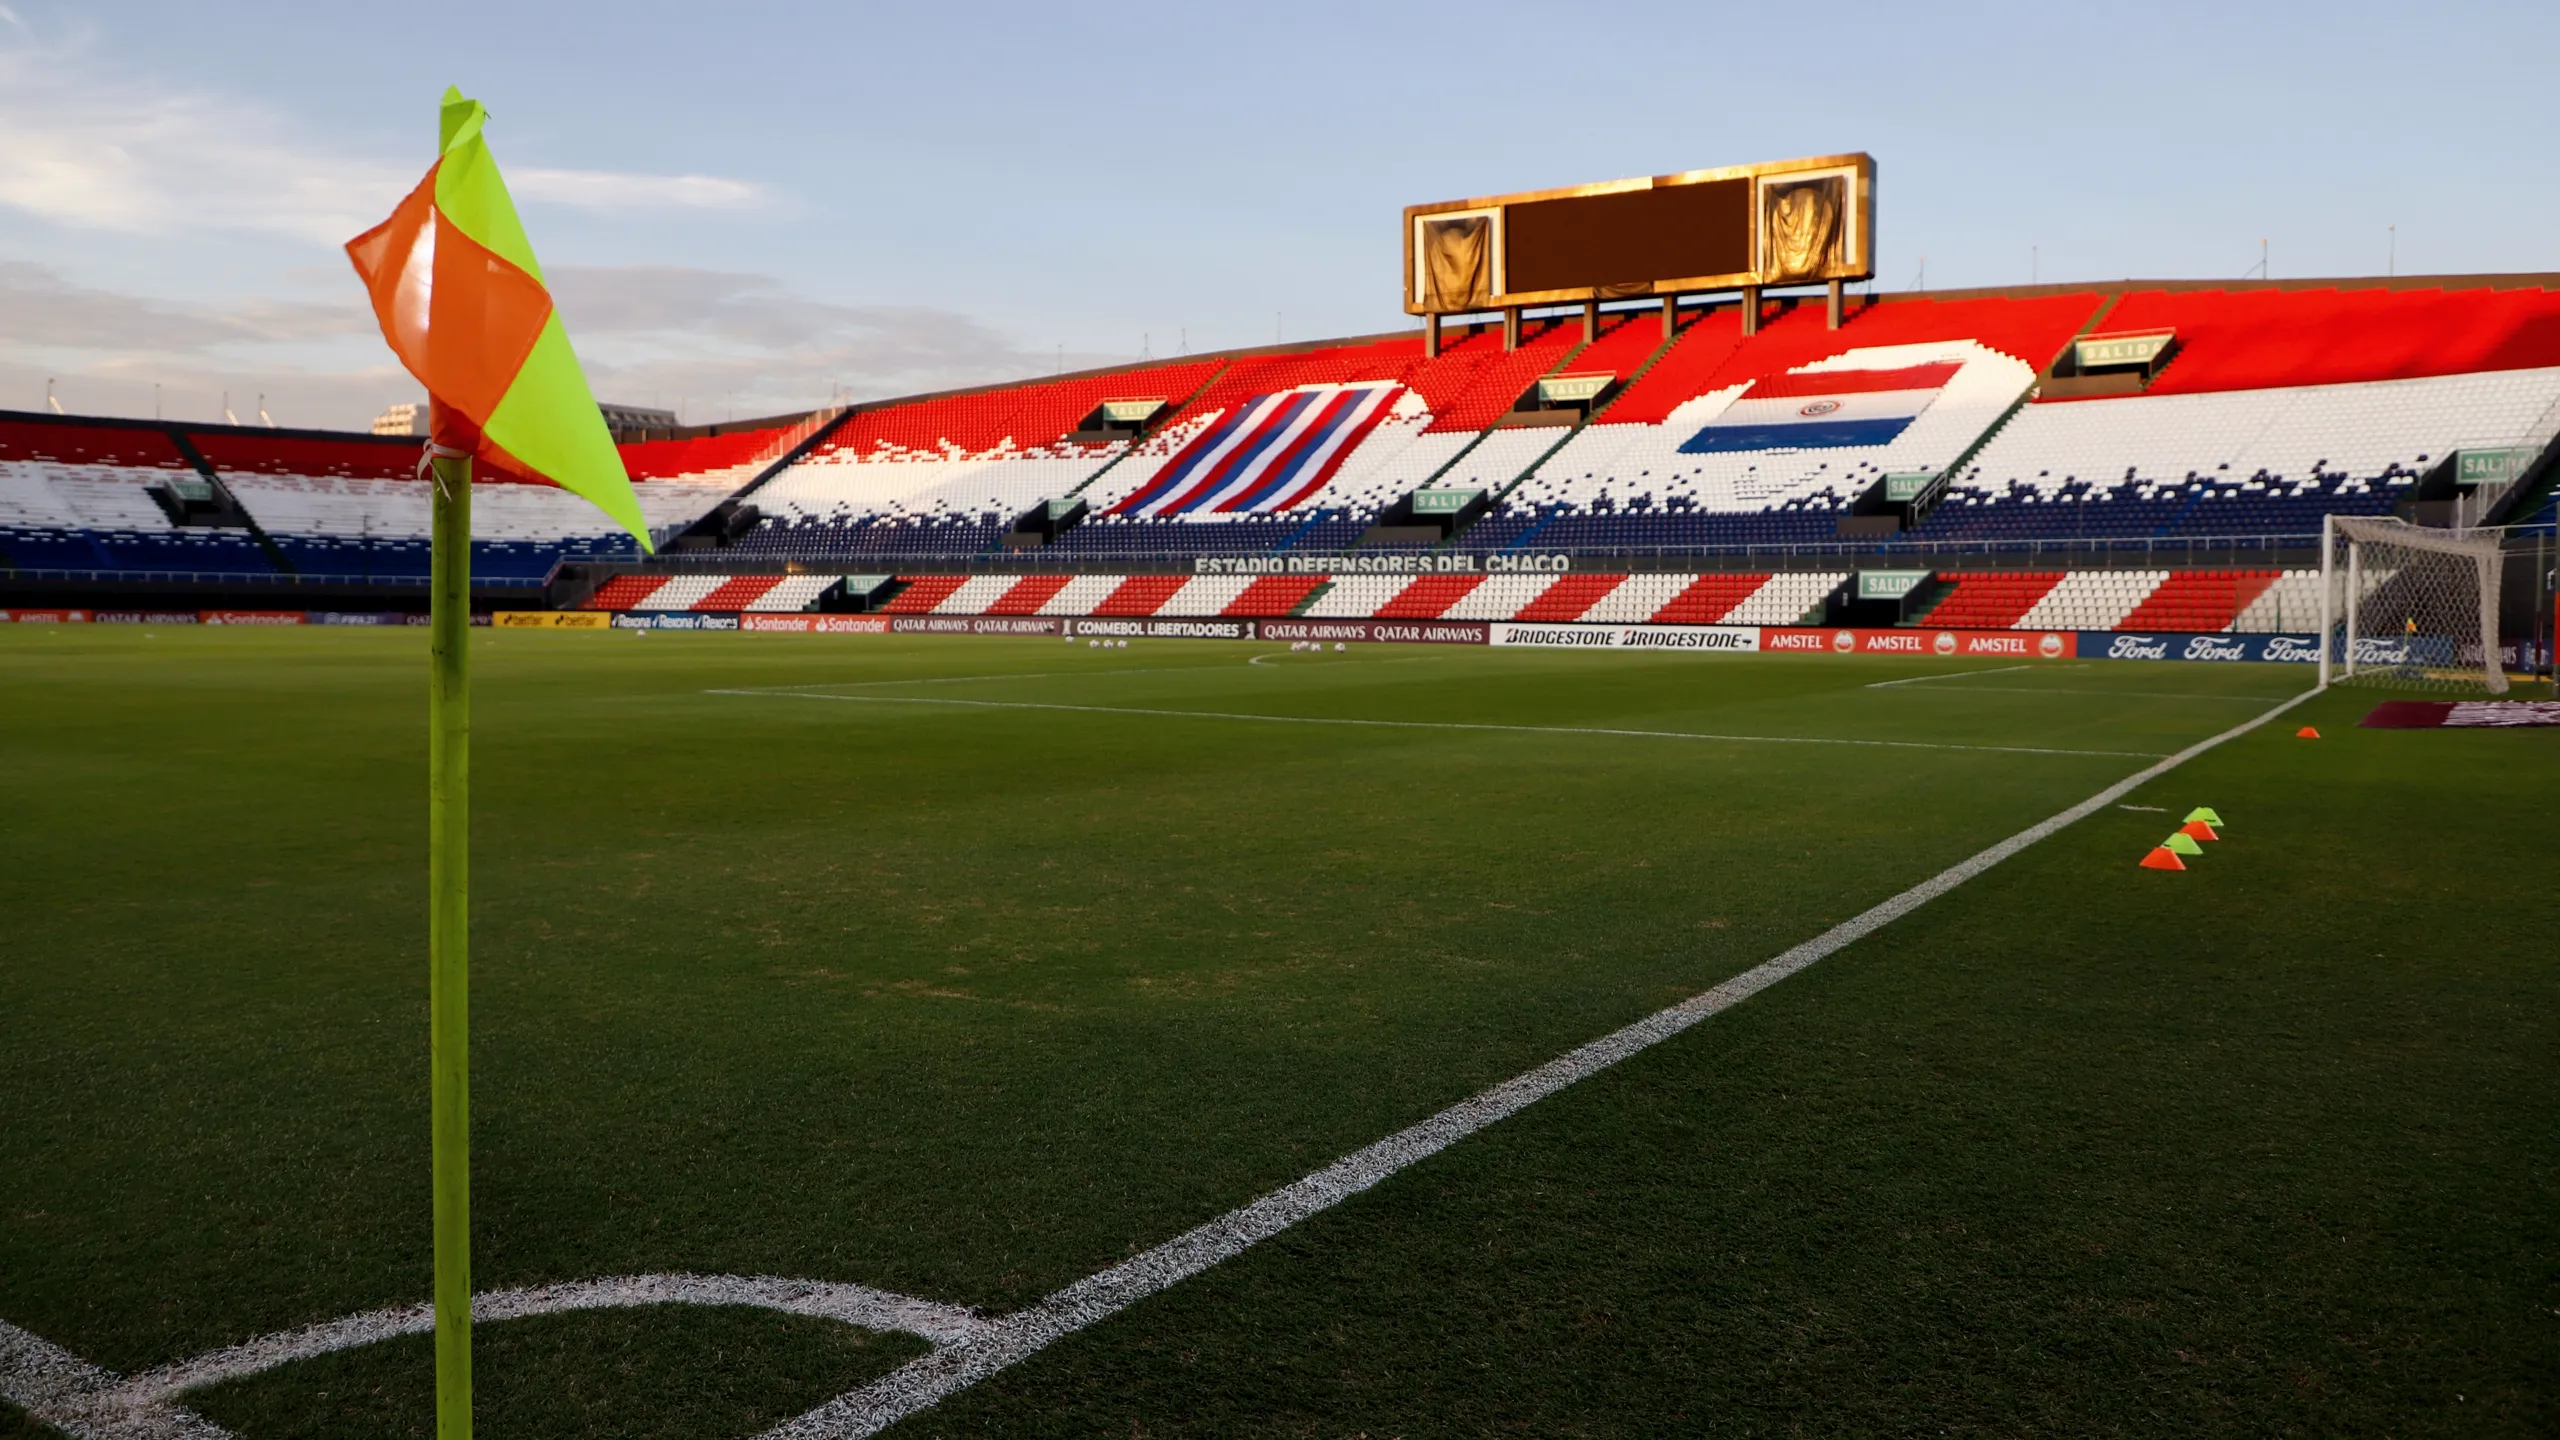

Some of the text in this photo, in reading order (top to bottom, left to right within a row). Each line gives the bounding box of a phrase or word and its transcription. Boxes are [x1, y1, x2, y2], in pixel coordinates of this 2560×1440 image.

[1890, 480, 1927, 494] SALID
[1417, 495, 1470, 507] SALID
[1196, 554, 1570, 572] ESTADIO DEFENSORES DEL CHACO
[96, 613, 141, 624] QATAR
[223, 613, 299, 625] Santander
[407, 615, 432, 625] QAT
[513, 614, 597, 626] betfair betfair
[620, 614, 651, 628] Rexona
[660, 614, 694, 628] Rexona
[755, 616, 887, 632] Santander Santander
[893, 619, 1055, 634] QATAR AIRWAYS QATAR AIRWAYS
[1077, 621, 1240, 637] CONMEBOL LIBERTADORES
[1264, 623, 1482, 642] QATAR AIRWAYS QATAR AIRWAYS
[1504, 628, 1742, 648] BRIDGESTONE BRIDGESTONE
[1770, 634, 2027, 652] AMSTEL AMSTEL AMSTEL
[2108, 635, 2168, 659] Ford
[2183, 636, 2245, 660] Ford
